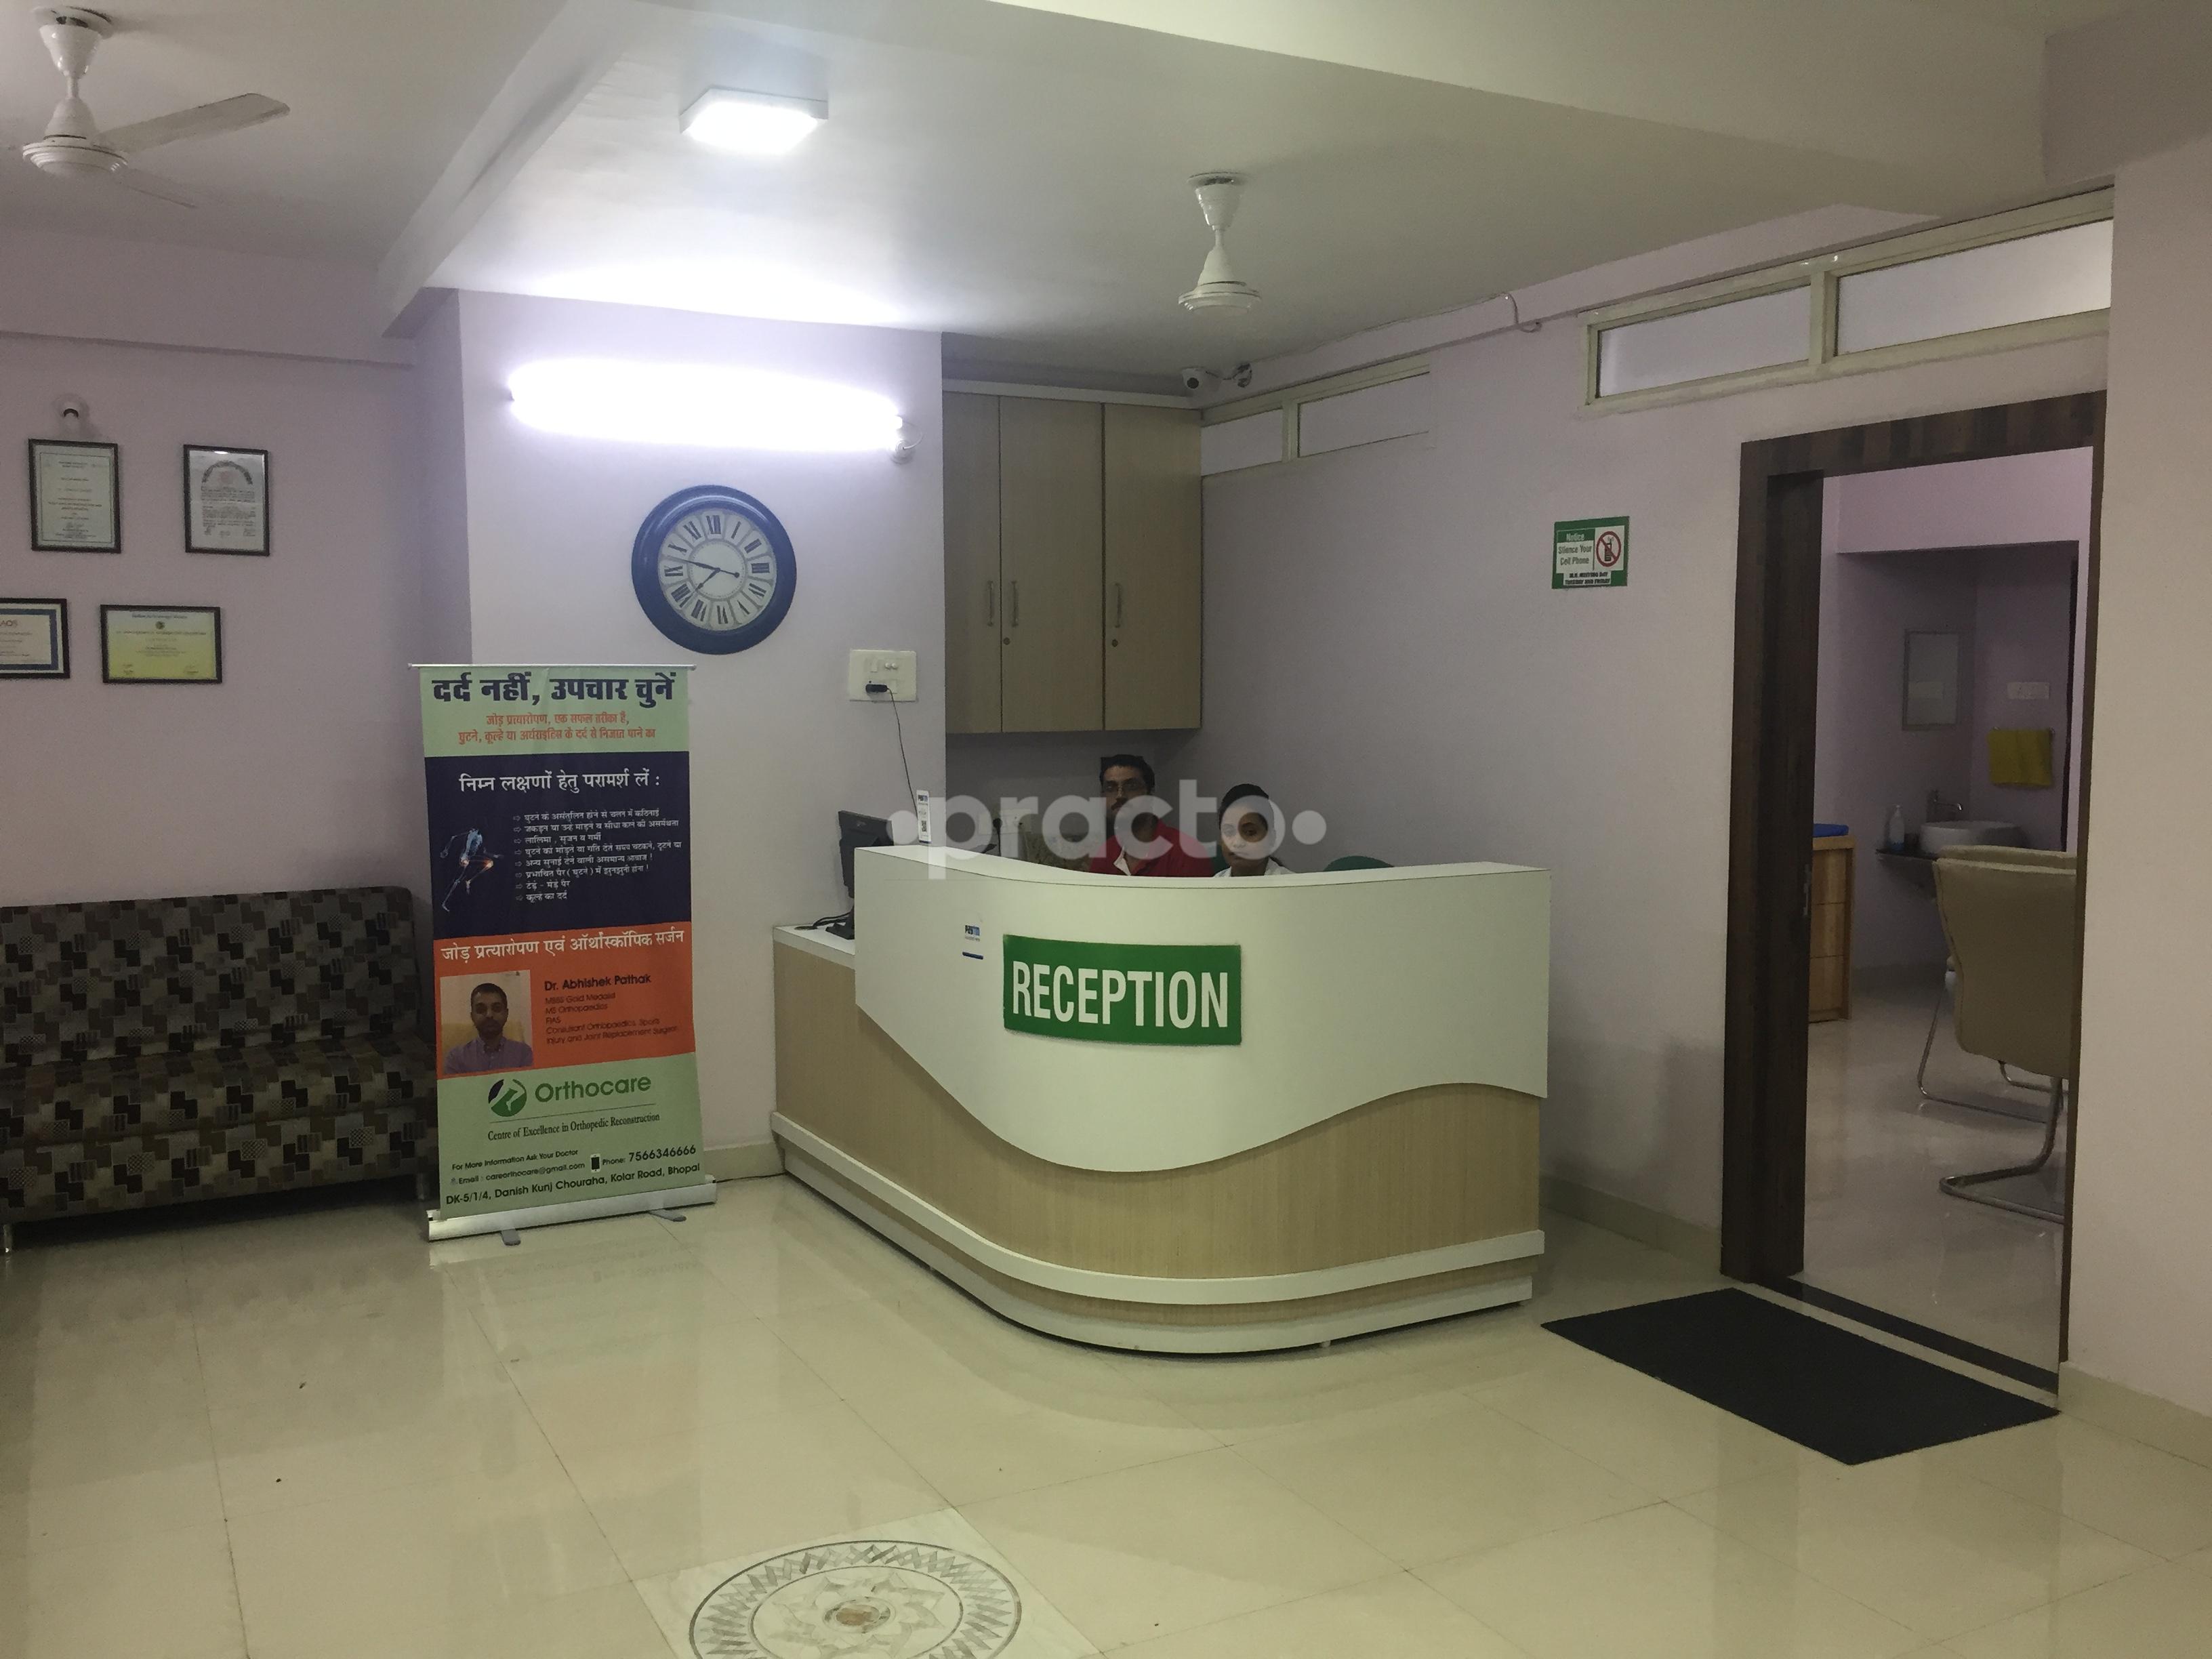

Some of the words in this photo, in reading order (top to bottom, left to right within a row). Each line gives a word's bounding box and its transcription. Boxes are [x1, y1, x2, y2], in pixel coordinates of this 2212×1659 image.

[1566, 533, 1585, 541] Notice
[1558, 546, 1578, 554] Silence
[1580, 544, 1592, 553] Your
[1560, 557, 1571, 566] Cell
[1572, 556, 1589, 565] Phone
[432, 672, 472, 701] दर्द
[479, 672, 540, 705] नहीं,
[550, 678, 629, 700] उपचार
[634, 672, 676, 708] चुनें
[554, 714, 568, 724] एक
[571, 714, 593, 724] सफल
[596, 712, 618, 724] तरीका
[506, 731, 516, 740] या
[565, 727, 573, 739] के
[575, 726, 587, 738] दर्द
[590, 726, 596, 738] से
[600, 727, 624, 739] निजात
[628, 726, 643, 738] पाने
[645, 729, 656, 738] का
[459, 773, 495, 792] निम्न
[499, 770, 552, 794] लक्षणों
[556, 769, 579, 794] हेतु
[582, 768, 630, 789] परामर्श
[634, 768, 650, 786] लें
[441, 942, 471, 964] जोड़
[474, 938, 540, 959] प्रत्यारोपण
[543, 935, 566, 957] एवं
[655, 926, 684, 944] सर्जन
[544, 981, 559, 991] Dr.
[562, 976, 612, 990] Abhishek
[614, 973, 651, 985] Pathak
[566, 995, 584, 1003] Gold
[586, 992, 616, 1001] Medalist
[1012, 961, 1227, 1029] RECEPTION
[558, 1003, 609, 1014] Orthopaedics
[546, 1024, 586, 1034] Consultant
[567, 1034, 583, 1042] and
[584, 1031, 601, 1040] Joint
[602, 1027, 652, 1039] Replacement
[535, 1076, 651, 1103] Orthocare
[488, 1130, 512, 1141] Centre
[513, 1128, 521, 1138] of
[523, 1124, 560, 1137] Excellence
[562, 1123, 569, 1132] in
[570, 1118, 609, 1132] Orthopedic
[610, 1113, 660, 1126] Reconstruction
[485, 1155, 525, 1166] Information
[555, 1149, 579, 1158] Doctor
[602, 1158, 626, 1166] Phone:
[629, 1145, 696, 1162] 7566346666
[446, 1190, 492, 1205] DK-5/1/4,
[495, 1185, 529, 1198] Danish
[531, 1181, 553, 1193] Kunj
[555, 1176, 608, 1190] Chouraha,
[610, 1172, 635, 1183] Kolar
[637, 1167, 665, 1180] Road,
[668, 1163, 700, 1175] Bhopal
[459, 1176, 479, 1185] Email
